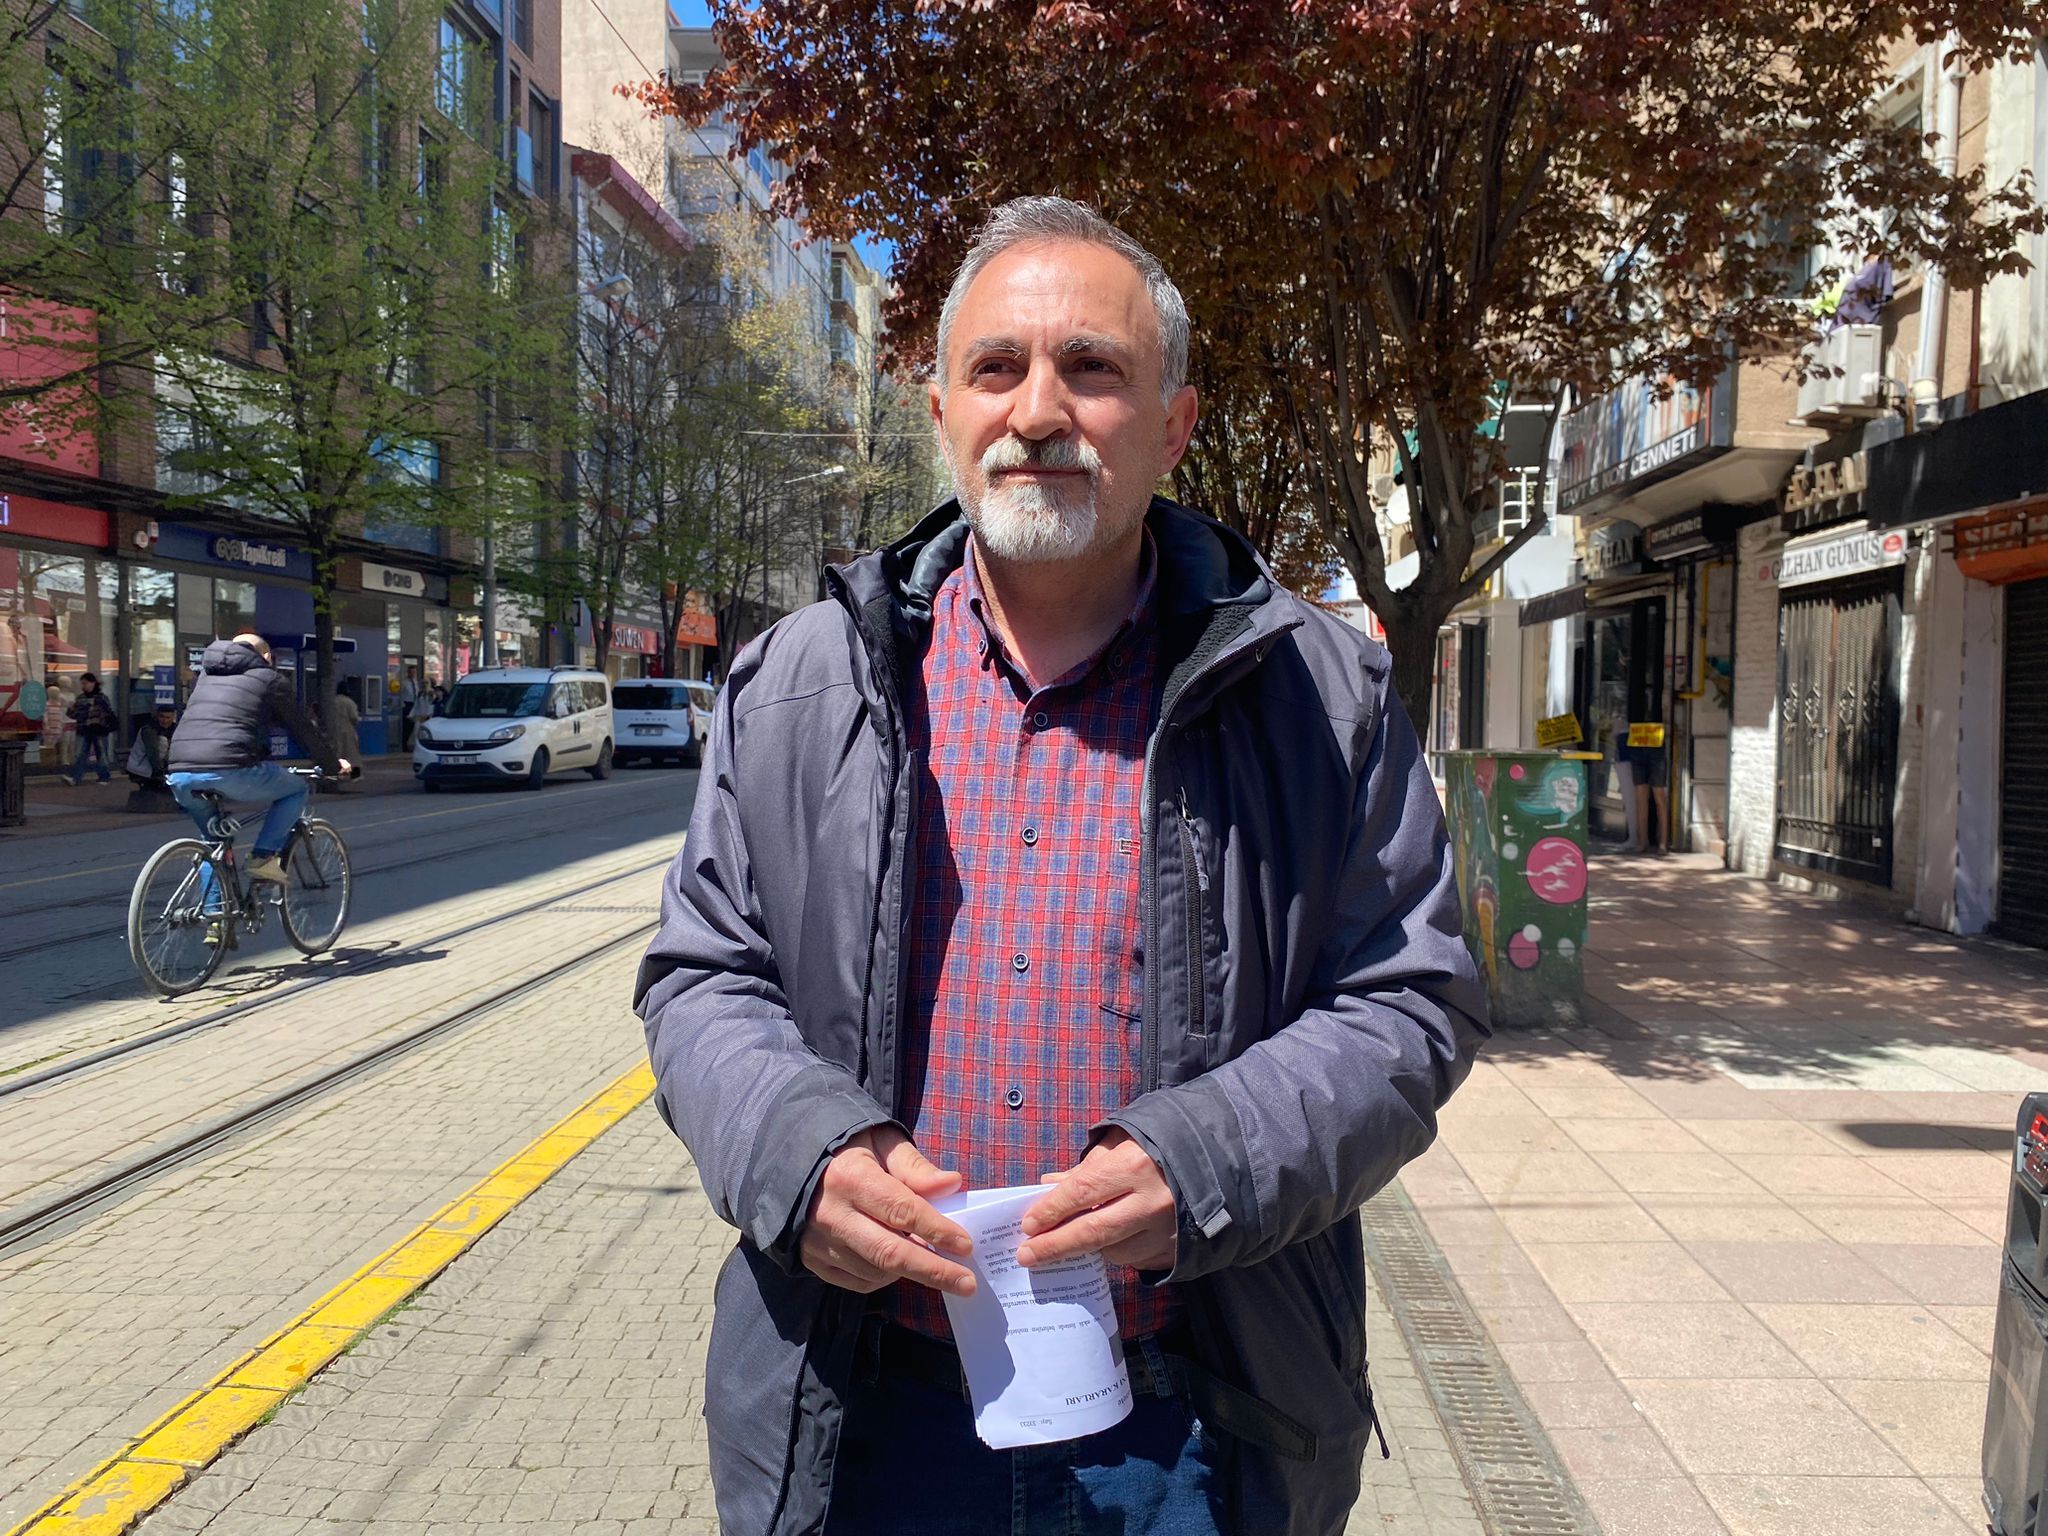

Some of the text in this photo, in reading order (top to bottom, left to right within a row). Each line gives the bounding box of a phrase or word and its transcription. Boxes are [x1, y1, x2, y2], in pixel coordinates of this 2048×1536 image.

[1589, 477, 1599, 495] &
[1630, 427, 1696, 477] CENNETİ
[393, 573, 412, 589] QNB
[614, 628, 644, 649] SUWEN
[1065, 1381, 1120, 1406] KARARLARI
